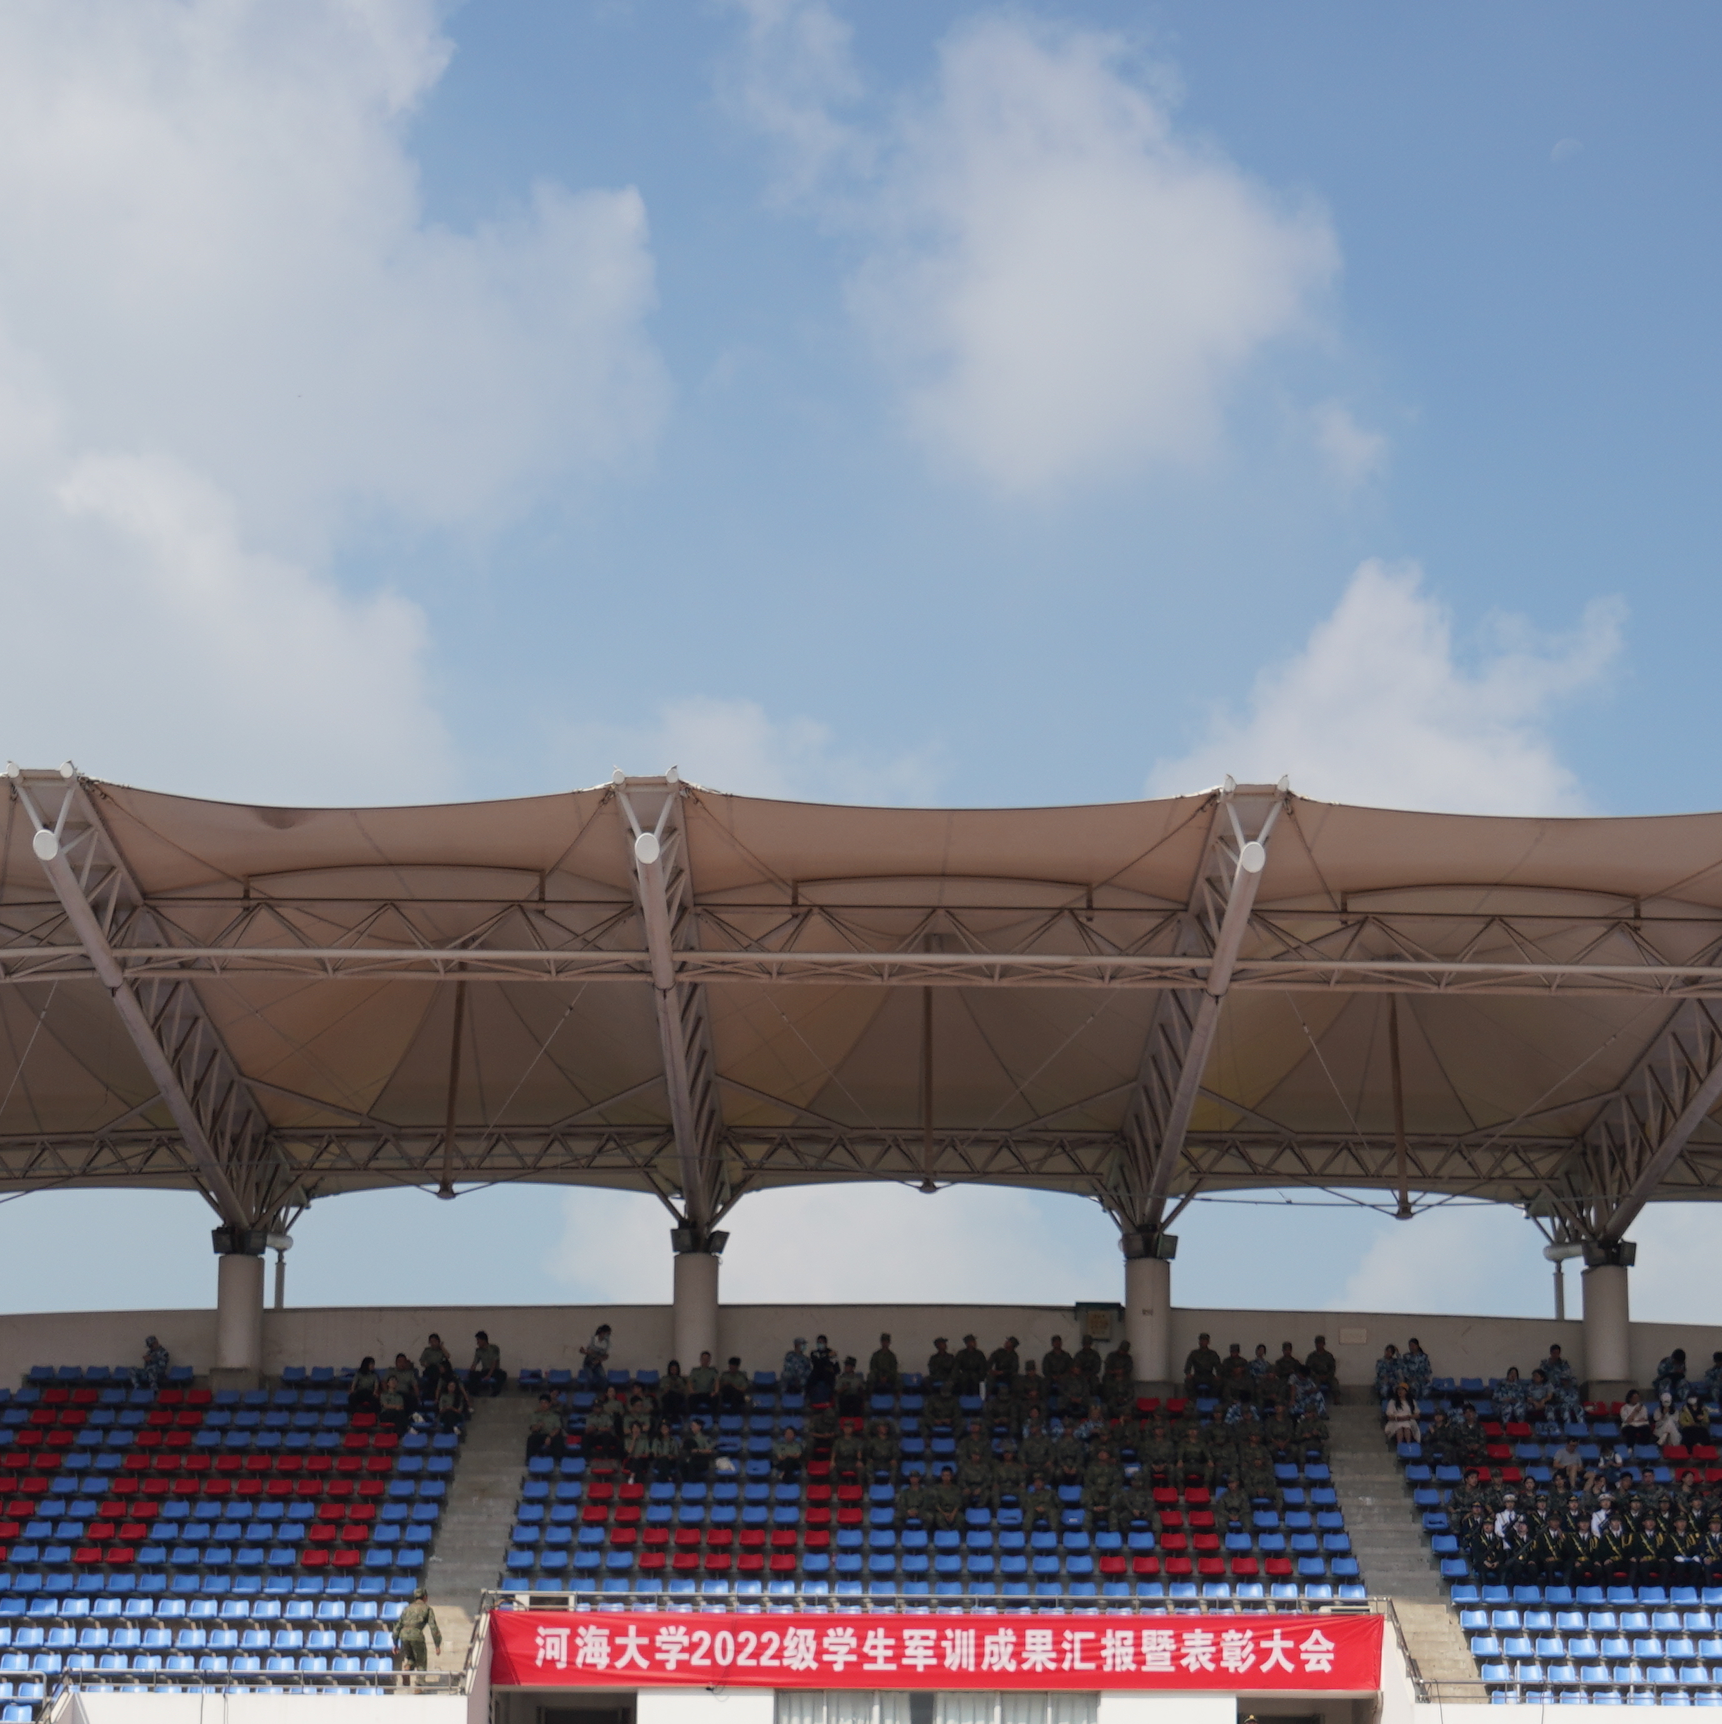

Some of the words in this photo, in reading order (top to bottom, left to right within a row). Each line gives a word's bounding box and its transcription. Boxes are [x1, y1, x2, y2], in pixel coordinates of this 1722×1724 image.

[535, 1625, 1335, 1673] 河海大学2022级学生军训成果汇报暨表彰大会
